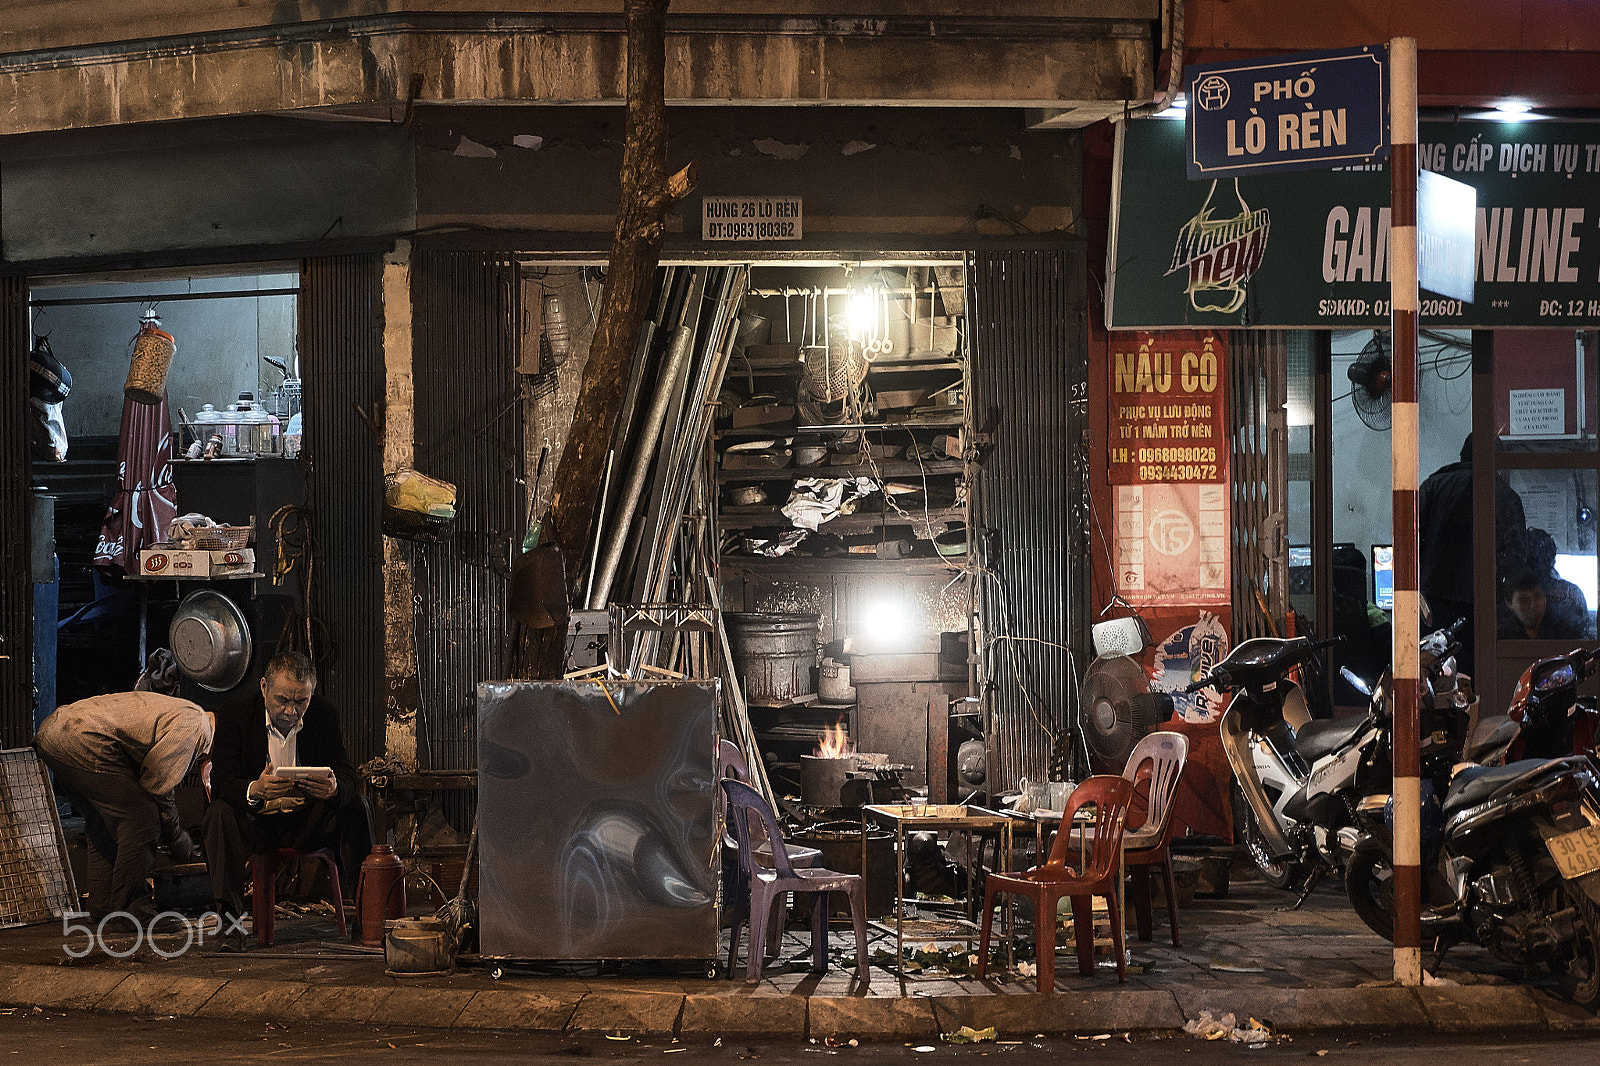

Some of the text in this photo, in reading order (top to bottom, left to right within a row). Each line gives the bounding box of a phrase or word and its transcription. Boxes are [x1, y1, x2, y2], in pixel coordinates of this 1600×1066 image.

[1254, 67, 1317, 102] PHỐ
[1226, 102, 1347, 156] LÒ RÈN
[1419, 143, 1446, 171] NG
[1452, 133, 1493, 172] CẤP
[1498, 144, 1547, 178] DỊCH
[1553, 144, 1579, 179] VỤ
[706, 198, 799, 218] HÙNG 26 LÒ RÈN
[1322, 205, 1391, 283] GA
[1474, 207, 1585, 282] NLINE
[1373, 299, 1463, 316] 0120601
[1539, 299, 1562, 316] ĐC:
[1567, 299, 1583, 316] 12
[1115, 336, 1218, 393] NẤU CỖ
[1119, 403, 1212, 421] PHỤC VỤ LƯU ĐỘNG
[1119, 420, 1212, 439] TỪ 1 MÂM TRỞ NÊN
[1112, 448, 1128, 463] LH
[1138, 447, 1216, 463] 0968098026
[1139, 465, 1217, 480] 0934430472
[1194, 637, 1214, 710] RVIVE
